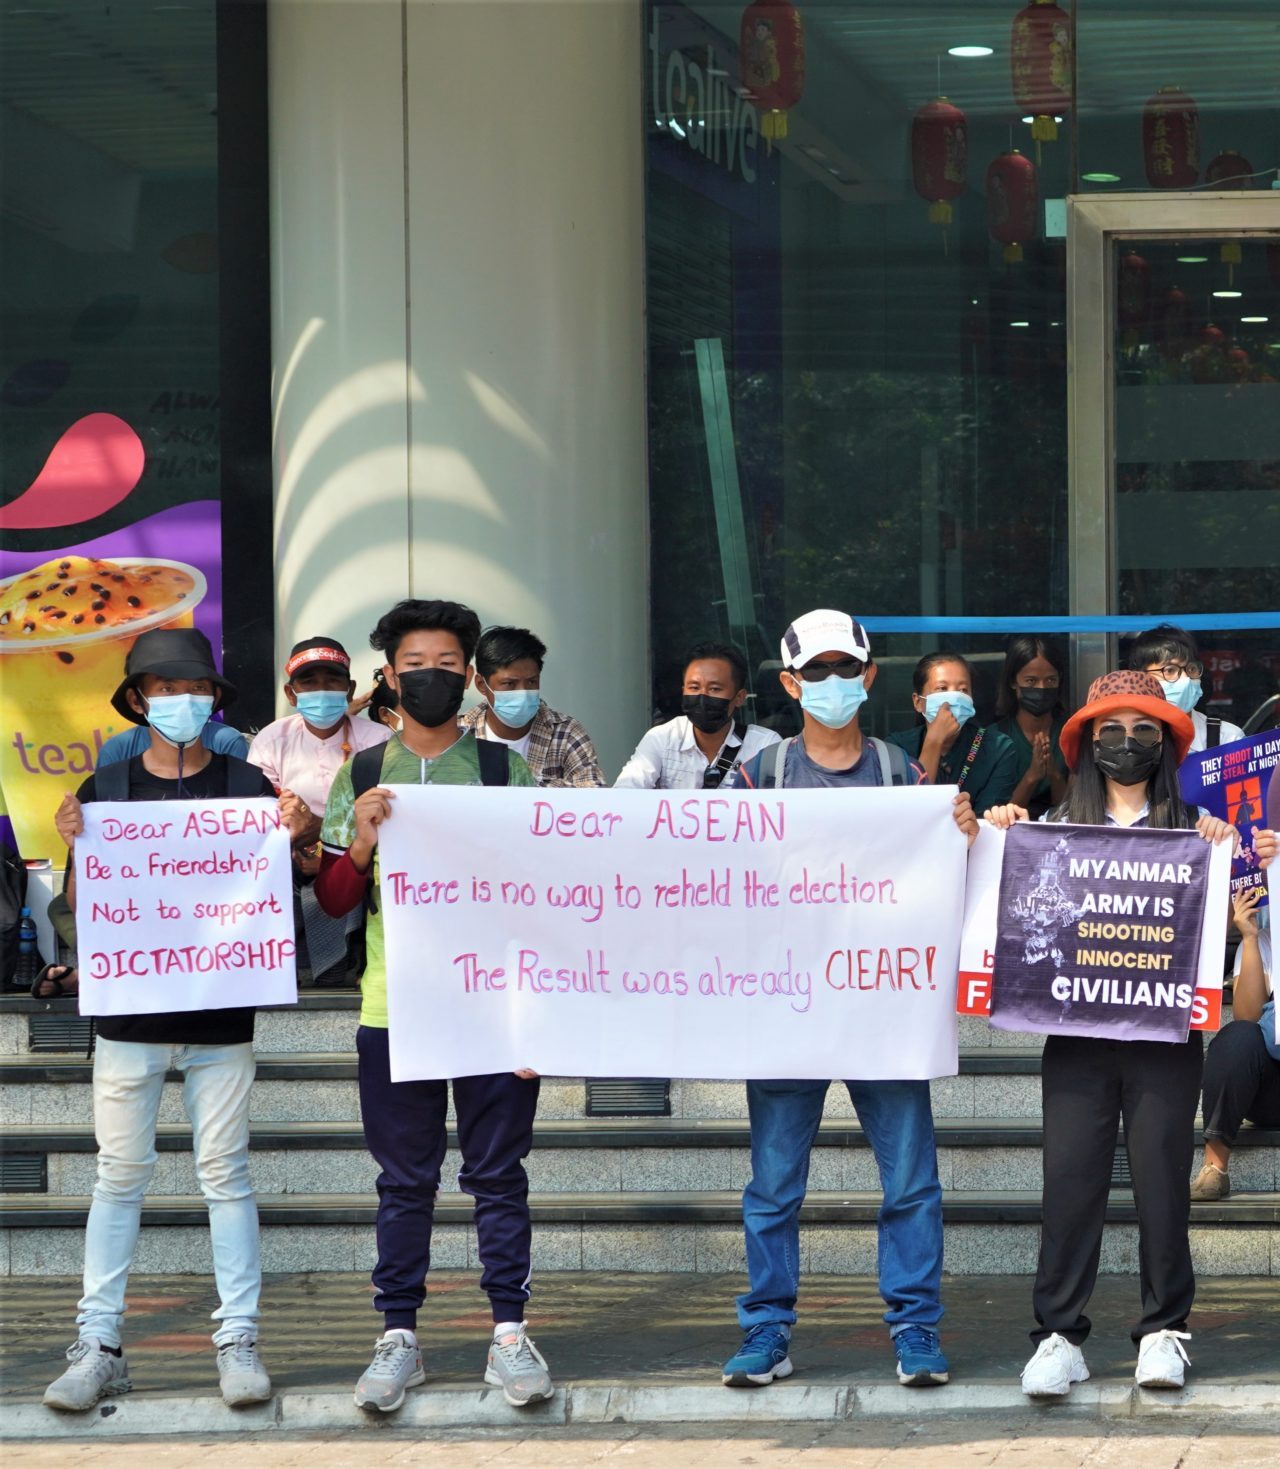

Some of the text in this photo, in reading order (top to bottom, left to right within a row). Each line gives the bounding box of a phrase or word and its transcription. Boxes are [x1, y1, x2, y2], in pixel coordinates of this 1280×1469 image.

[12, 729, 106, 775] teal
[1201, 757, 1222, 773] THEY
[1224, 748, 1251, 766] SHOOT
[1253, 744, 1264, 757] IN
[1202, 773, 1221, 786] THEY
[1223, 765, 1246, 780] STEAL
[1247, 760, 1259, 774] AT
[102, 808, 282, 843] Dear ASEAN
[530, 799, 784, 842] Dear ASEAN
[86, 856, 112, 880] Be
[122, 863, 139, 879] a
[1069, 859, 1192, 884] MYANMAR
[1231, 874, 1253, 890] THERE
[387, 862, 897, 922] There is no way to reheld the election
[1081, 893, 1175, 918] ARMY IS
[92, 894, 282, 925] Not to support
[1078, 922, 1175, 943] SHOOTING
[90, 939, 296, 980] DICTATORSHIP
[1076, 950, 1173, 970] INNOCENT
[453, 953, 506, 993] The
[517, 949, 611, 993] Result
[622, 970, 688, 995] was
[699, 949, 811, 1013] already
[1051, 976, 1192, 1008] CIVILIANS
